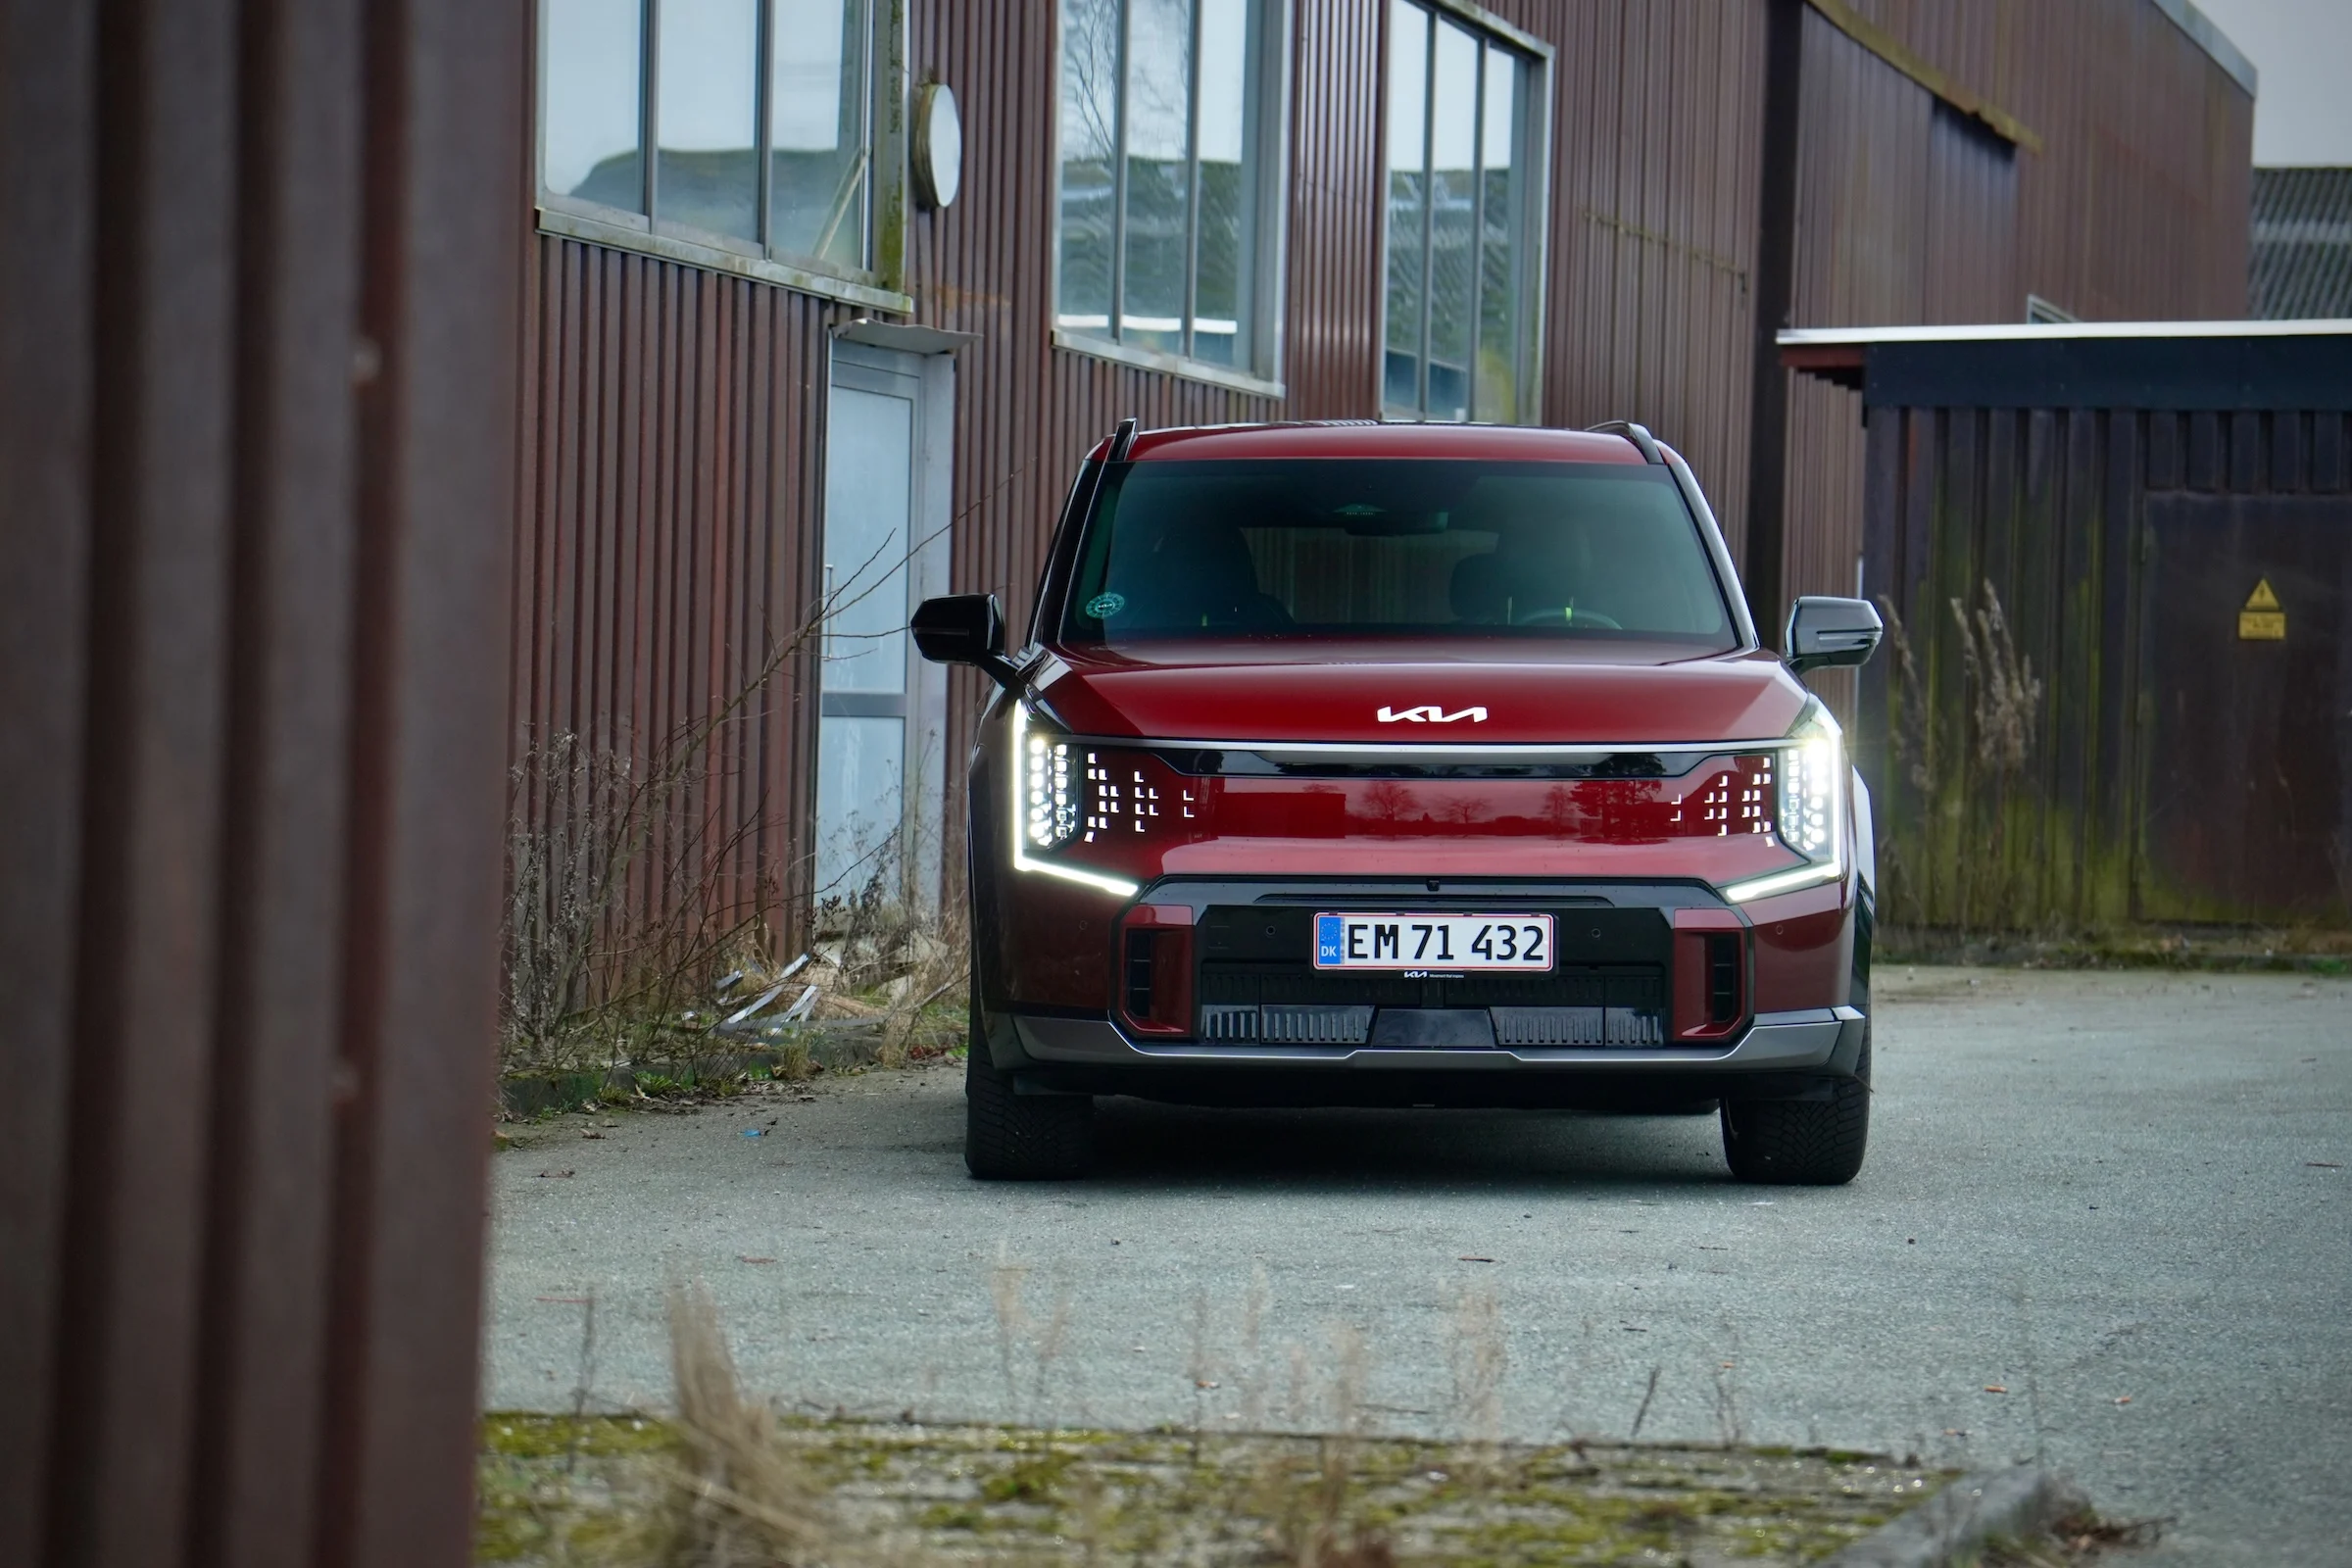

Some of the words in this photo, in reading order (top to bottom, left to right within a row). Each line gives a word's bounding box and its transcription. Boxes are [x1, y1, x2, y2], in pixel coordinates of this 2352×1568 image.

[1377, 706, 1488, 722] KIA
[1348, 924, 1398, 959] EM
[1412, 924, 1454, 960] 71
[1471, 924, 1544, 961] 432
[1321, 946, 1337, 956] DK
